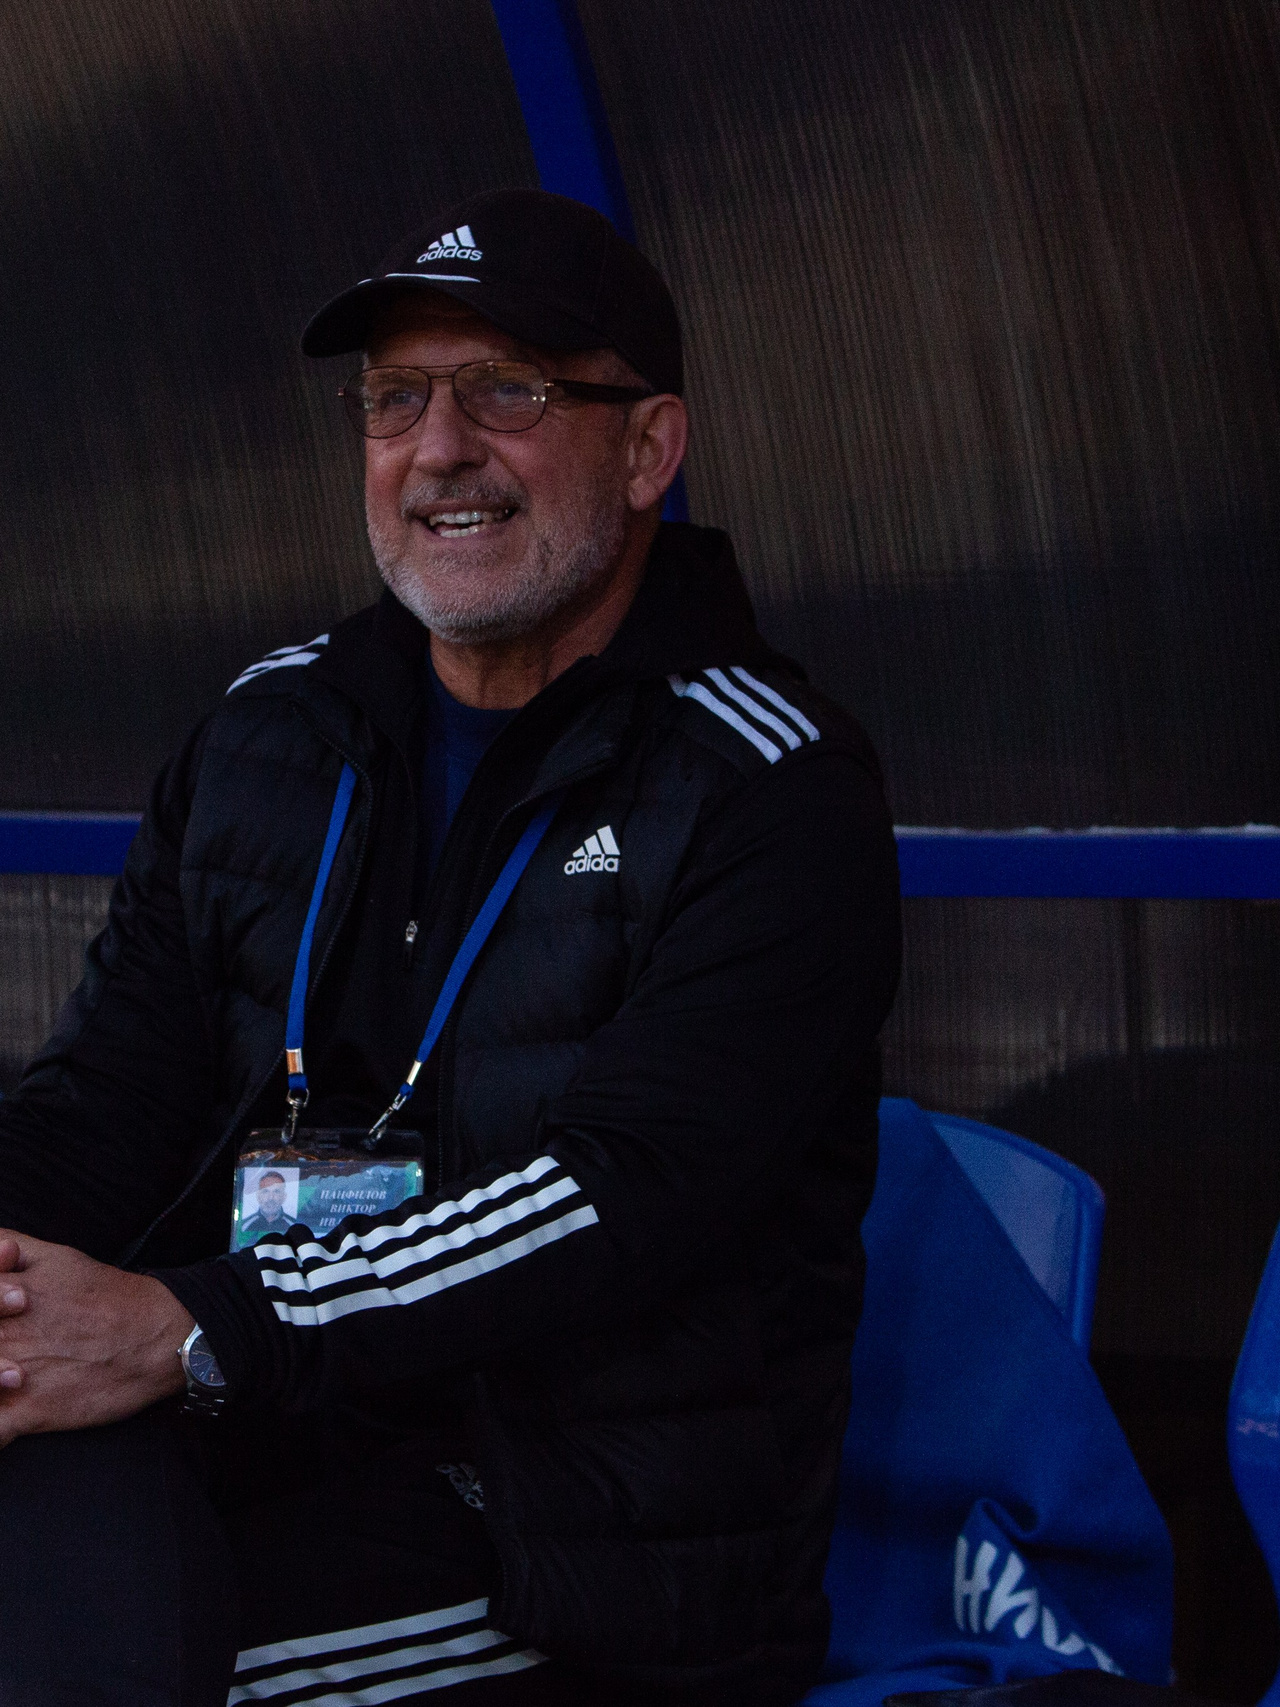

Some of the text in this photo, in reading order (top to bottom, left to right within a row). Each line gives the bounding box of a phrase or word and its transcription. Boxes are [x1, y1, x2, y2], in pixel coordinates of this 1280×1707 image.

[416, 245, 483, 264] adidas
[563, 853, 620, 876] adida
[320, 1189, 387, 1200] ПАНФИЛОВ
[330, 1204, 376, 1214] ВИКТОР
[319, 1217, 342, 1227] ИВ
